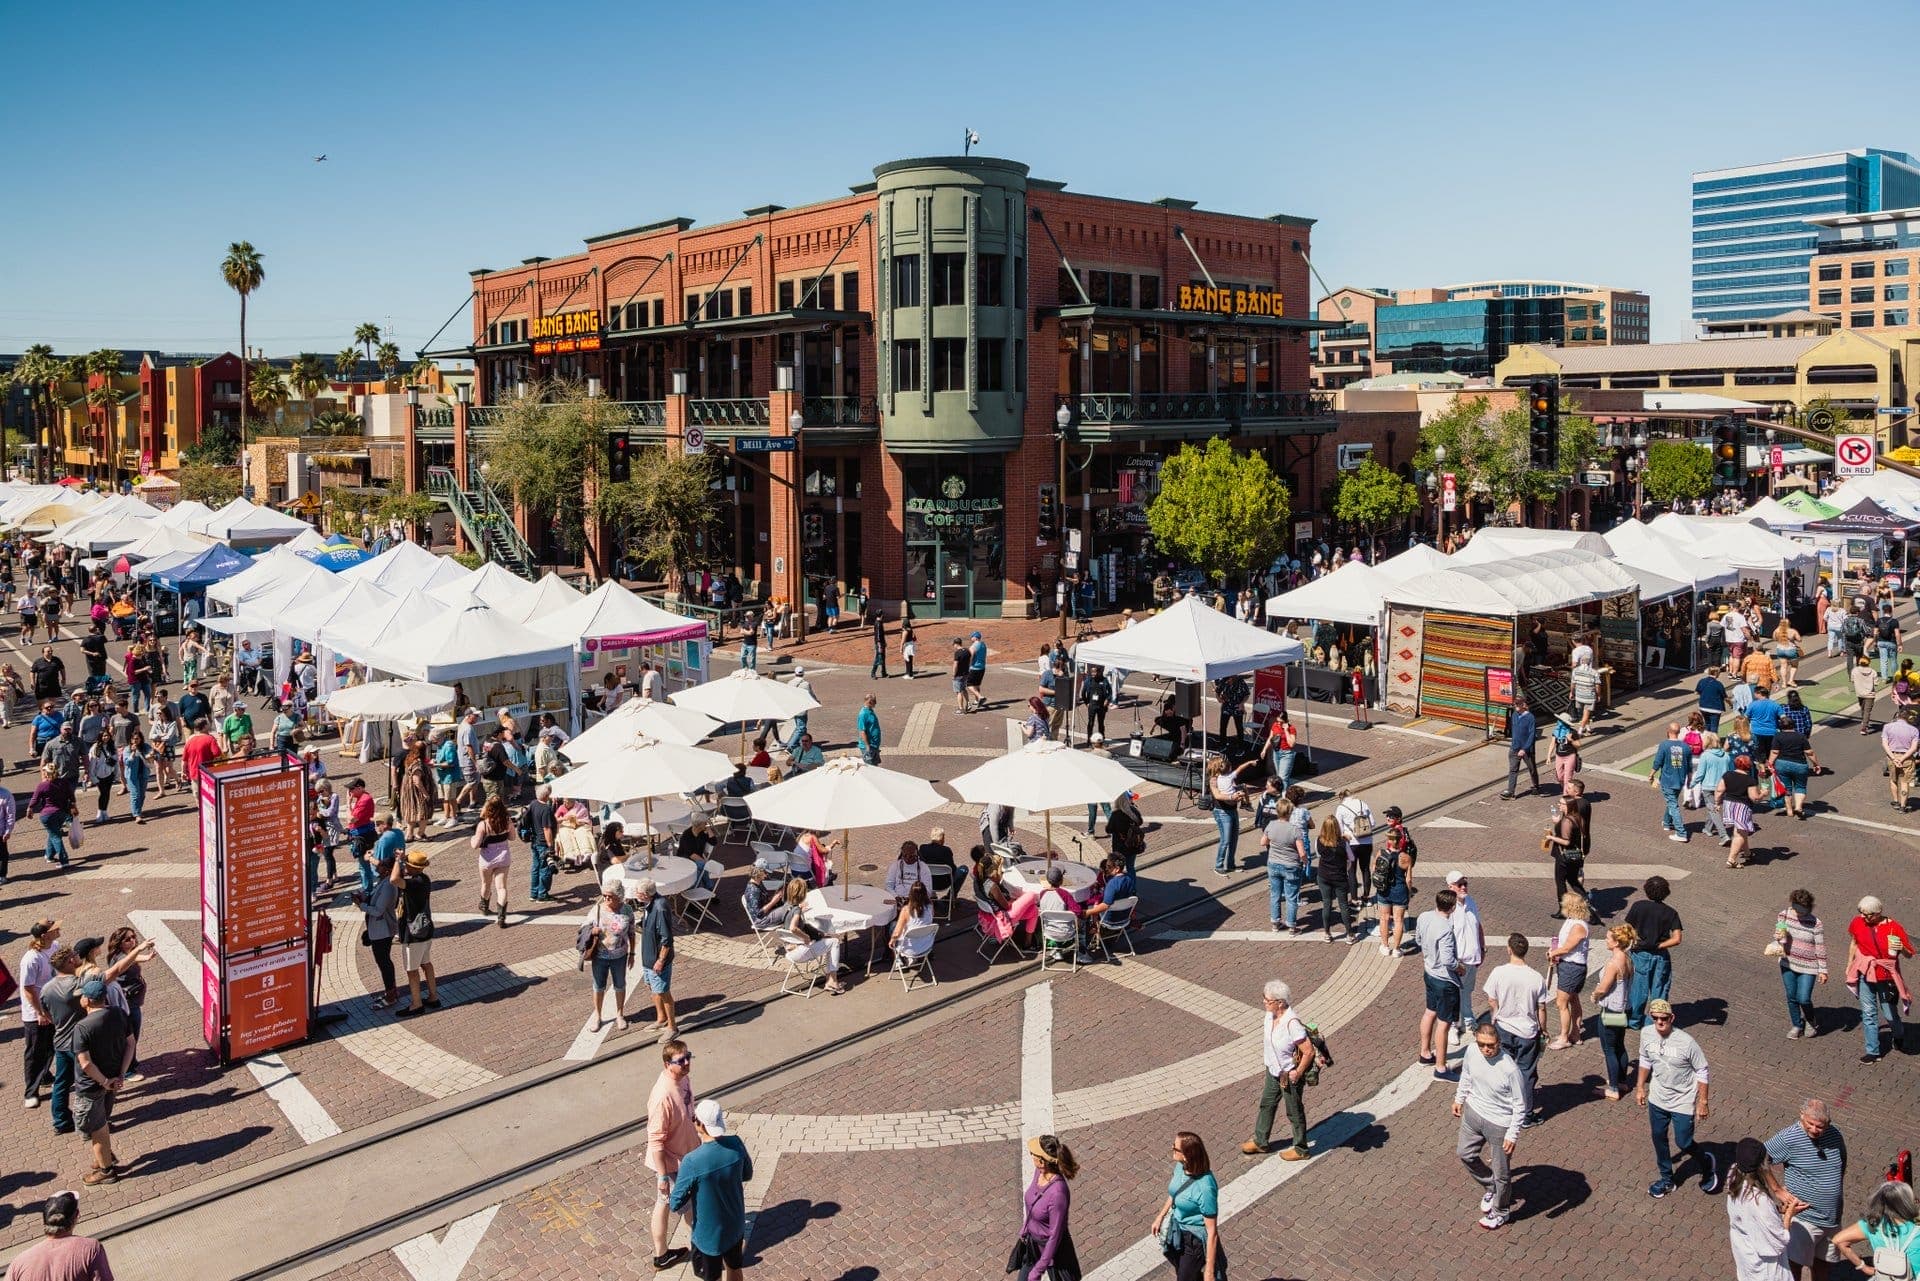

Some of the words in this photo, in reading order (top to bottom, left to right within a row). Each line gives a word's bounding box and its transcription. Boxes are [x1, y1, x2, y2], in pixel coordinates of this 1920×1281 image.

[1180, 285, 1231, 314] BANG
[1236, 290, 1284, 317] BANG
[533, 315, 563, 338] BANG
[565, 310, 599, 335] BANG
[534, 342, 551, 352] SUSHI
[558, 341, 575, 351] SAKE
[580, 338, 600, 349] MUSIC
[742, 440, 762, 449] Mill
[765, 441, 782, 449] Ave
[1126, 456, 1154, 467] Lotions
[1840, 466, 1852, 474] ON
[1854, 466, 1871, 474] RED
[908, 498, 1000, 511] STARBUCKS
[924, 513, 985, 526] COFFEE
[229, 785, 265, 799] FESTIVAL
[277, 778, 297, 791] ARTS
[272, 1018, 298, 1031] photos
